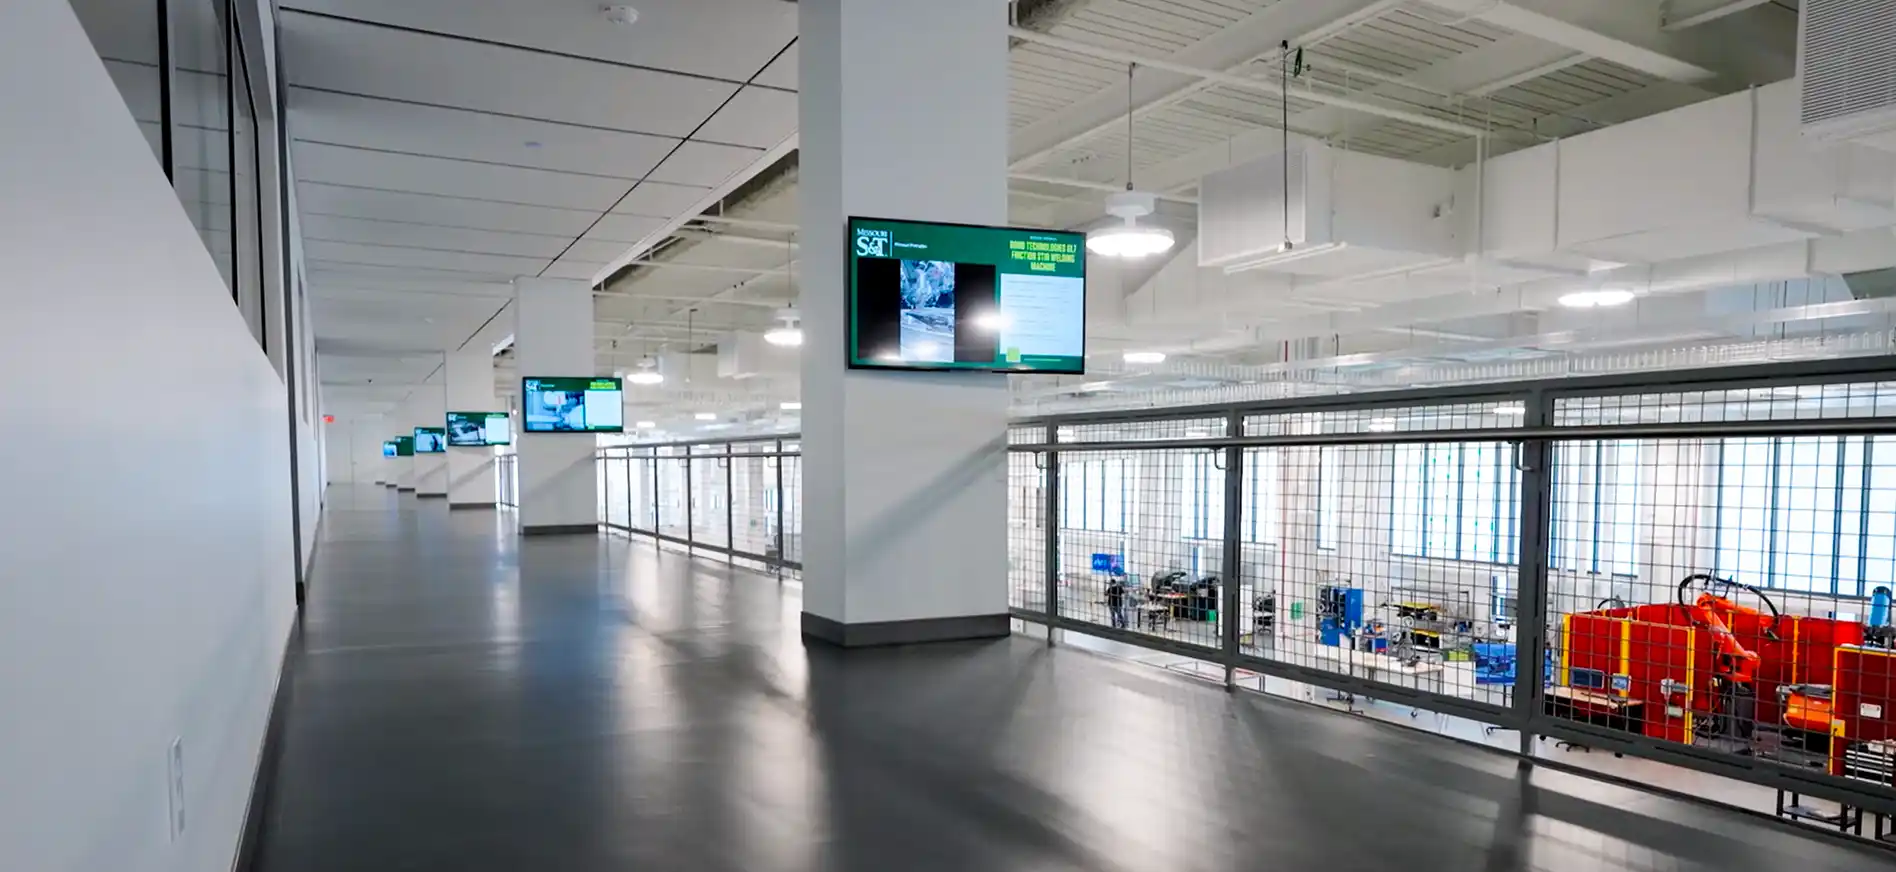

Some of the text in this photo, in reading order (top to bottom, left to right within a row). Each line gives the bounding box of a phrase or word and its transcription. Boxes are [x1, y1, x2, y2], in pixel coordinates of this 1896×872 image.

[856, 236, 888, 256] S&T
[1026, 241, 1066, 252] TECHNOLOGIES
[1011, 250, 1036, 260] FRICTION
[1051, 253, 1075, 263] WELDING
